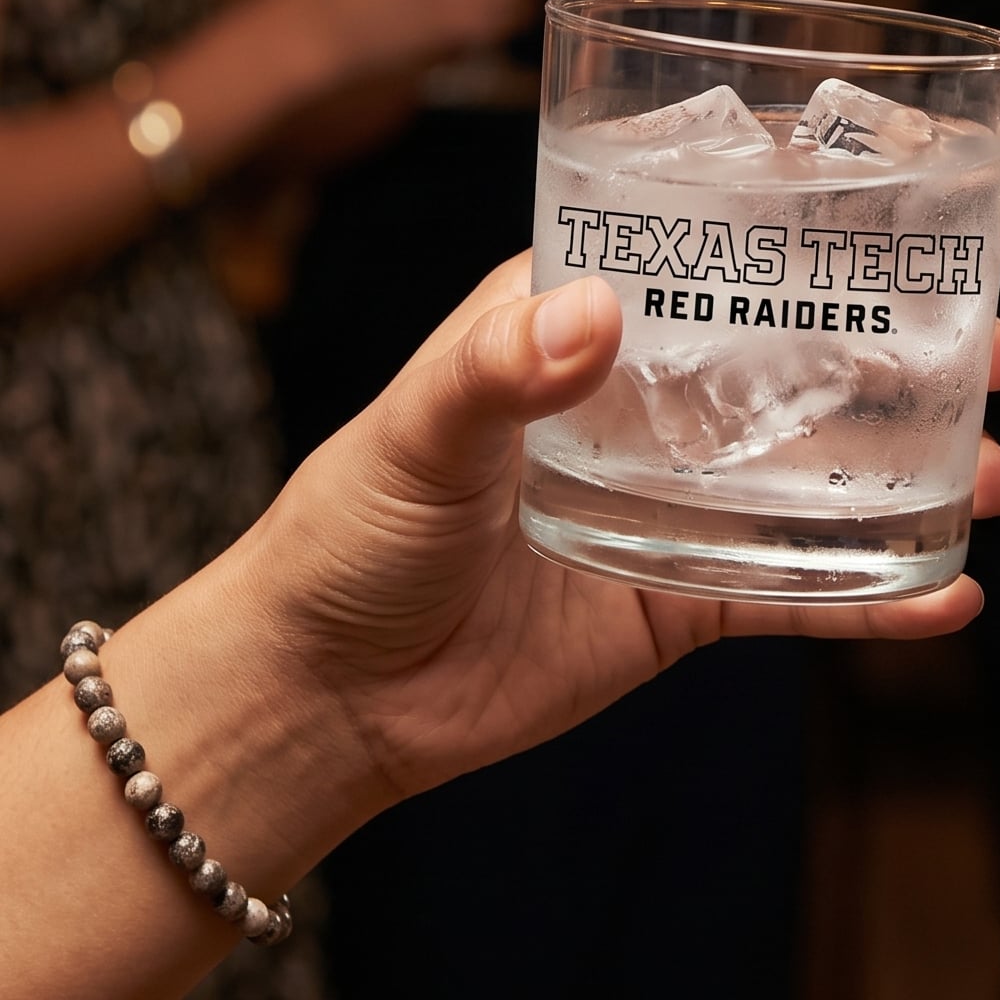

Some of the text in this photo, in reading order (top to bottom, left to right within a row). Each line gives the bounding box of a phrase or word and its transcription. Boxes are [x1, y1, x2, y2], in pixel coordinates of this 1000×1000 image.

[558, 206, 984, 295] TEXAS TECH
[643, 288, 714, 322] RED
